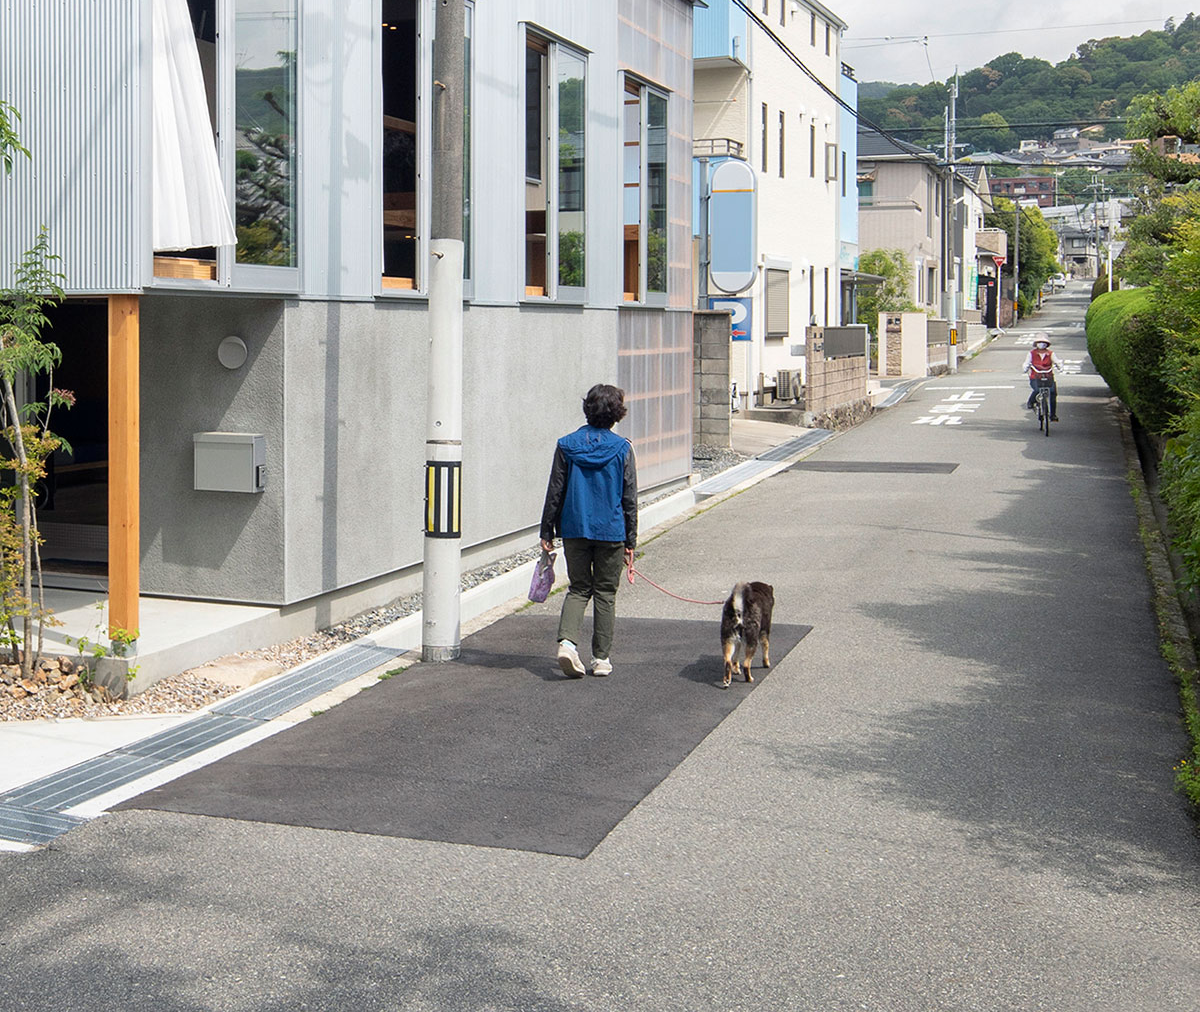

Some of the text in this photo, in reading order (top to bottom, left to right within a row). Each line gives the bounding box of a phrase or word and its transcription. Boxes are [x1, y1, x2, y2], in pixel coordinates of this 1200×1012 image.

[713, 301, 748, 324] P
[911, 390, 986, 426] 止まれ
